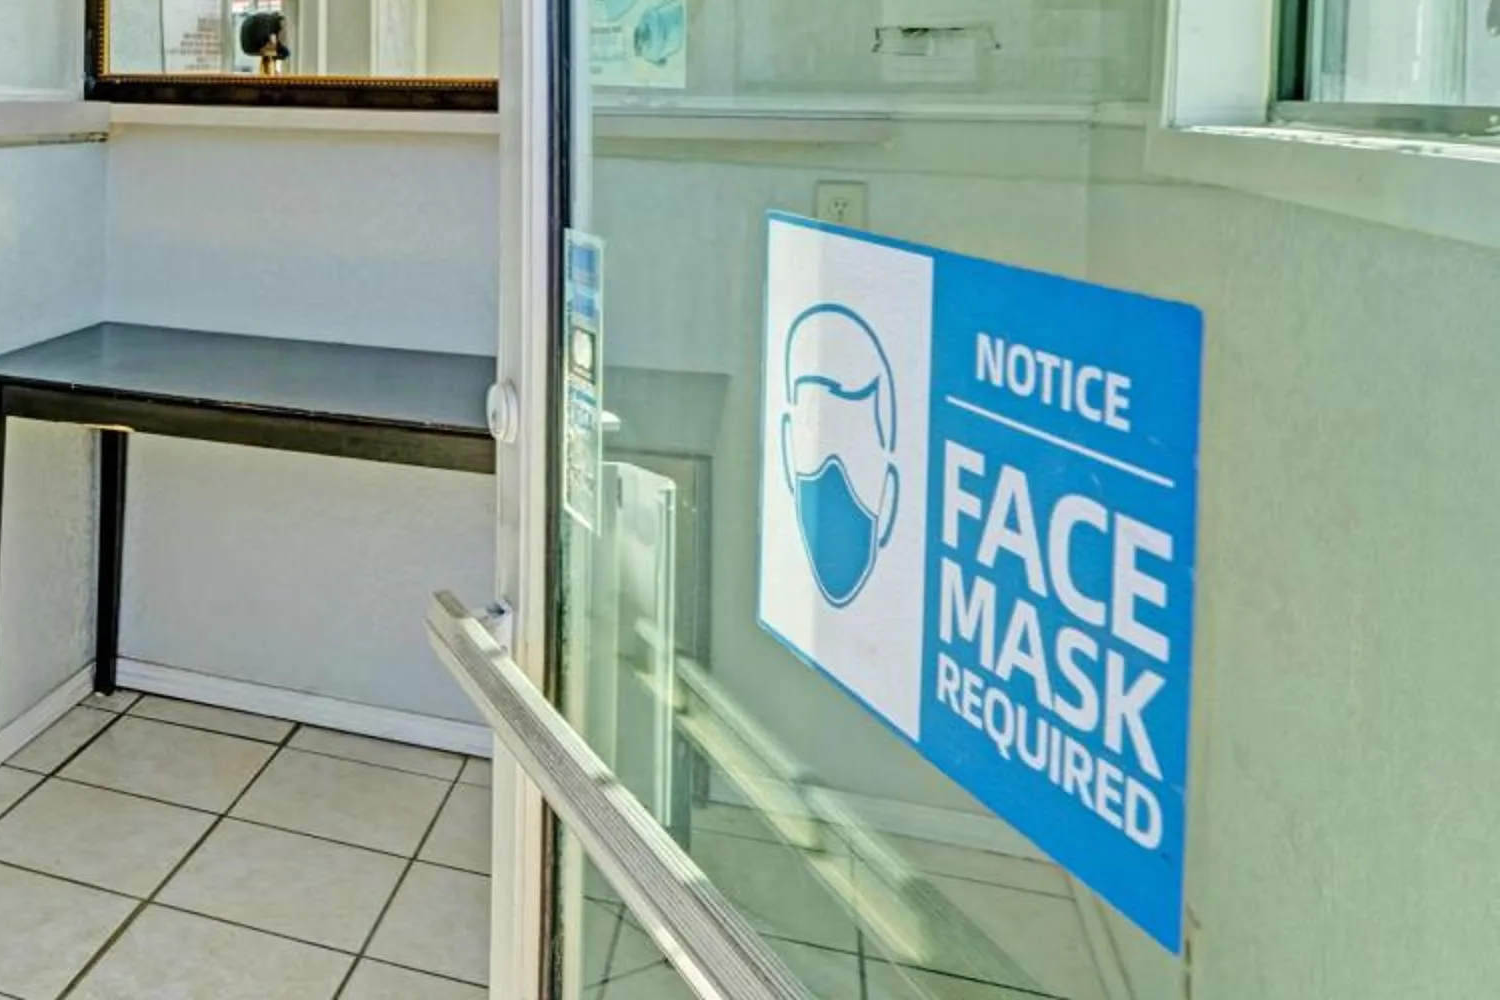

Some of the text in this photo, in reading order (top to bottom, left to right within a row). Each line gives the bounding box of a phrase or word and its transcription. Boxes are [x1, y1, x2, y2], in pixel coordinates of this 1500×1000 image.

[976, 332, 1131, 432] NOTICE
[943, 439, 1174, 663] FACE
[937, 652, 1163, 850] REQUIRED
[939, 557, 1165, 781] MASK
